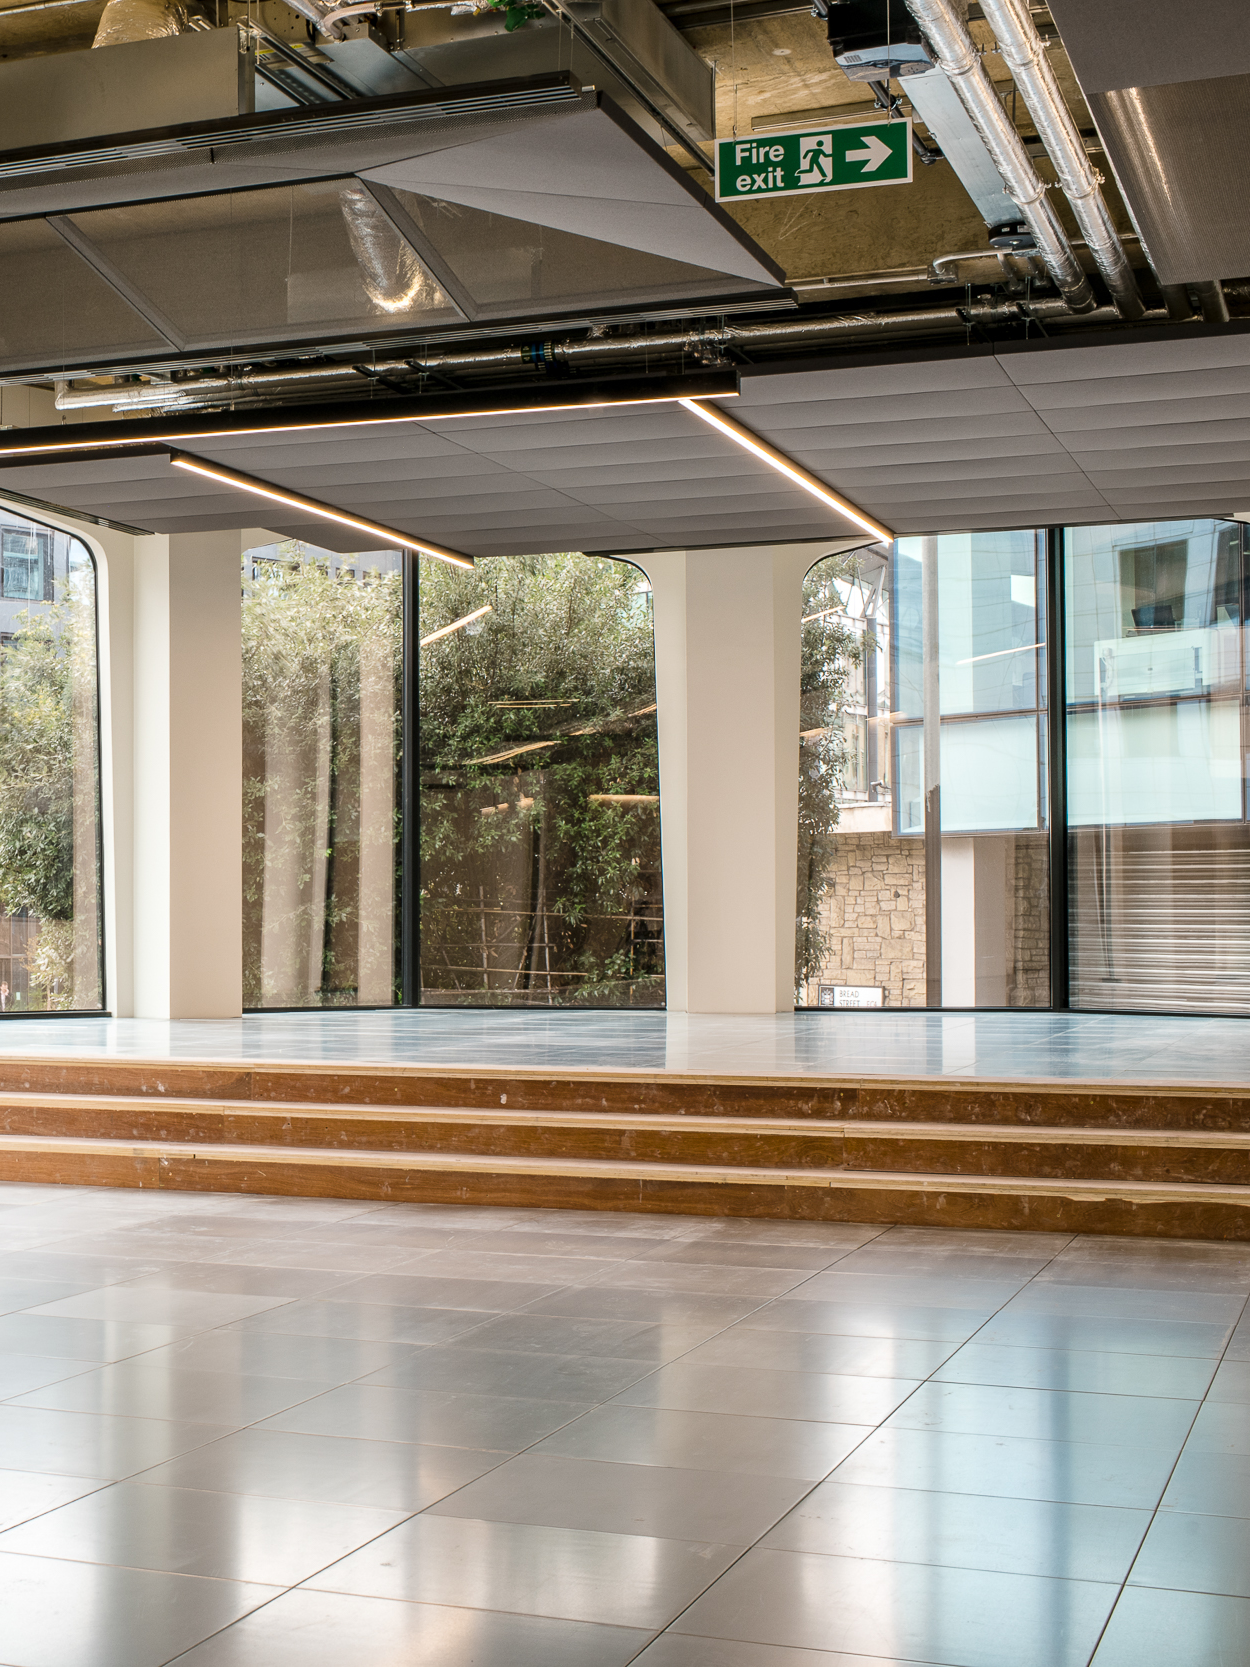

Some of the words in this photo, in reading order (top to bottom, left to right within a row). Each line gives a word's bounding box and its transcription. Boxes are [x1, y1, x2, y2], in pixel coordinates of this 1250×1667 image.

[735, 142, 785, 166] Fire
[735, 167, 785, 192] exit
[839, 989, 860, 998] BREAD
[839, 999, 860, 1007] STREET
